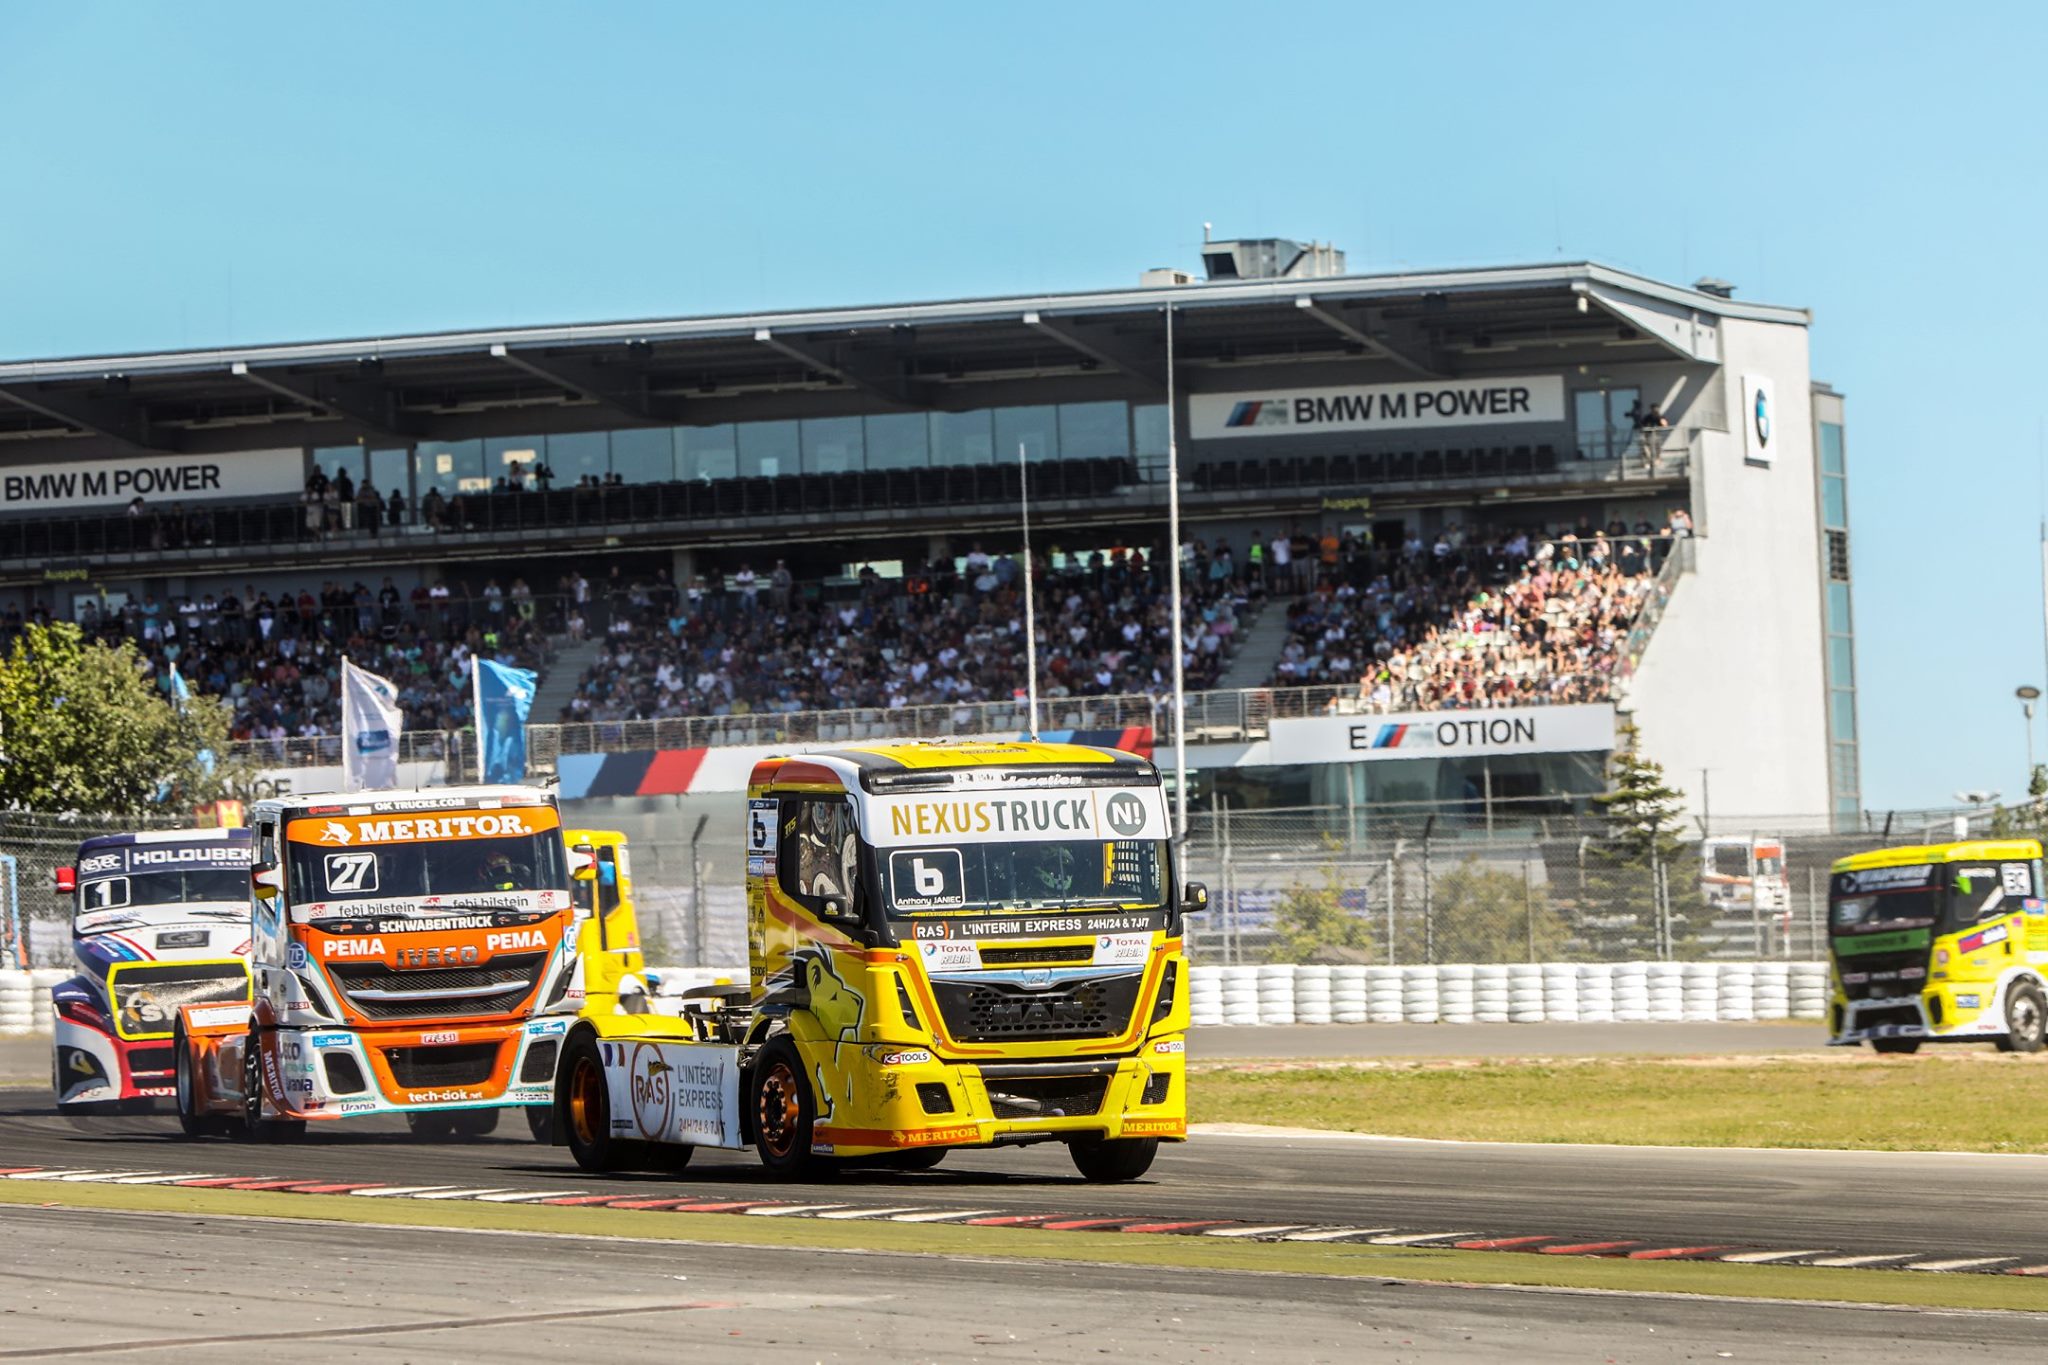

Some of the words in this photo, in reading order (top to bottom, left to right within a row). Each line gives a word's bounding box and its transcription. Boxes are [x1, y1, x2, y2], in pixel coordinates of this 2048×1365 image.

[1294, 394, 1373, 424] BMW
[1380, 393, 1408, 418] M
[1415, 387, 1531, 419] POWER
[5, 473, 76, 501] BMW
[83, 471, 107, 497] M
[114, 464, 221, 495] POWER
[891, 799, 1090, 836] NEXUSTRUCK
[329, 855, 374, 891] 27
[95, 880, 112, 906] 1
[367, 902, 416, 916] bilstein
[379, 915, 493, 933] SCHWABENTRUCK
[962, 921, 1020, 935] L'INTERIM
[1025, 919, 1082, 933] EXPRESS
[1087, 918, 1121, 930] 24H/24
[1122, 918, 1130, 929] &
[323, 938, 386, 957] PEMA
[486, 929, 548, 951] PEMA
[941, 944, 975, 953] TOTAL
[1115, 938, 1147, 946] TOTAL
[396, 945, 479, 968] IVECO
[883, 1053, 900, 1064] KS
[900, 1052, 929, 1063] TOOLS
[635, 1075, 665, 1105] RAS
[679, 1088, 724, 1110] EXPRESS
[340, 1102, 376, 1112] Urania
[907, 1127, 979, 1143] MERITOR
[1123, 1121, 1178, 1133] MERITOR
